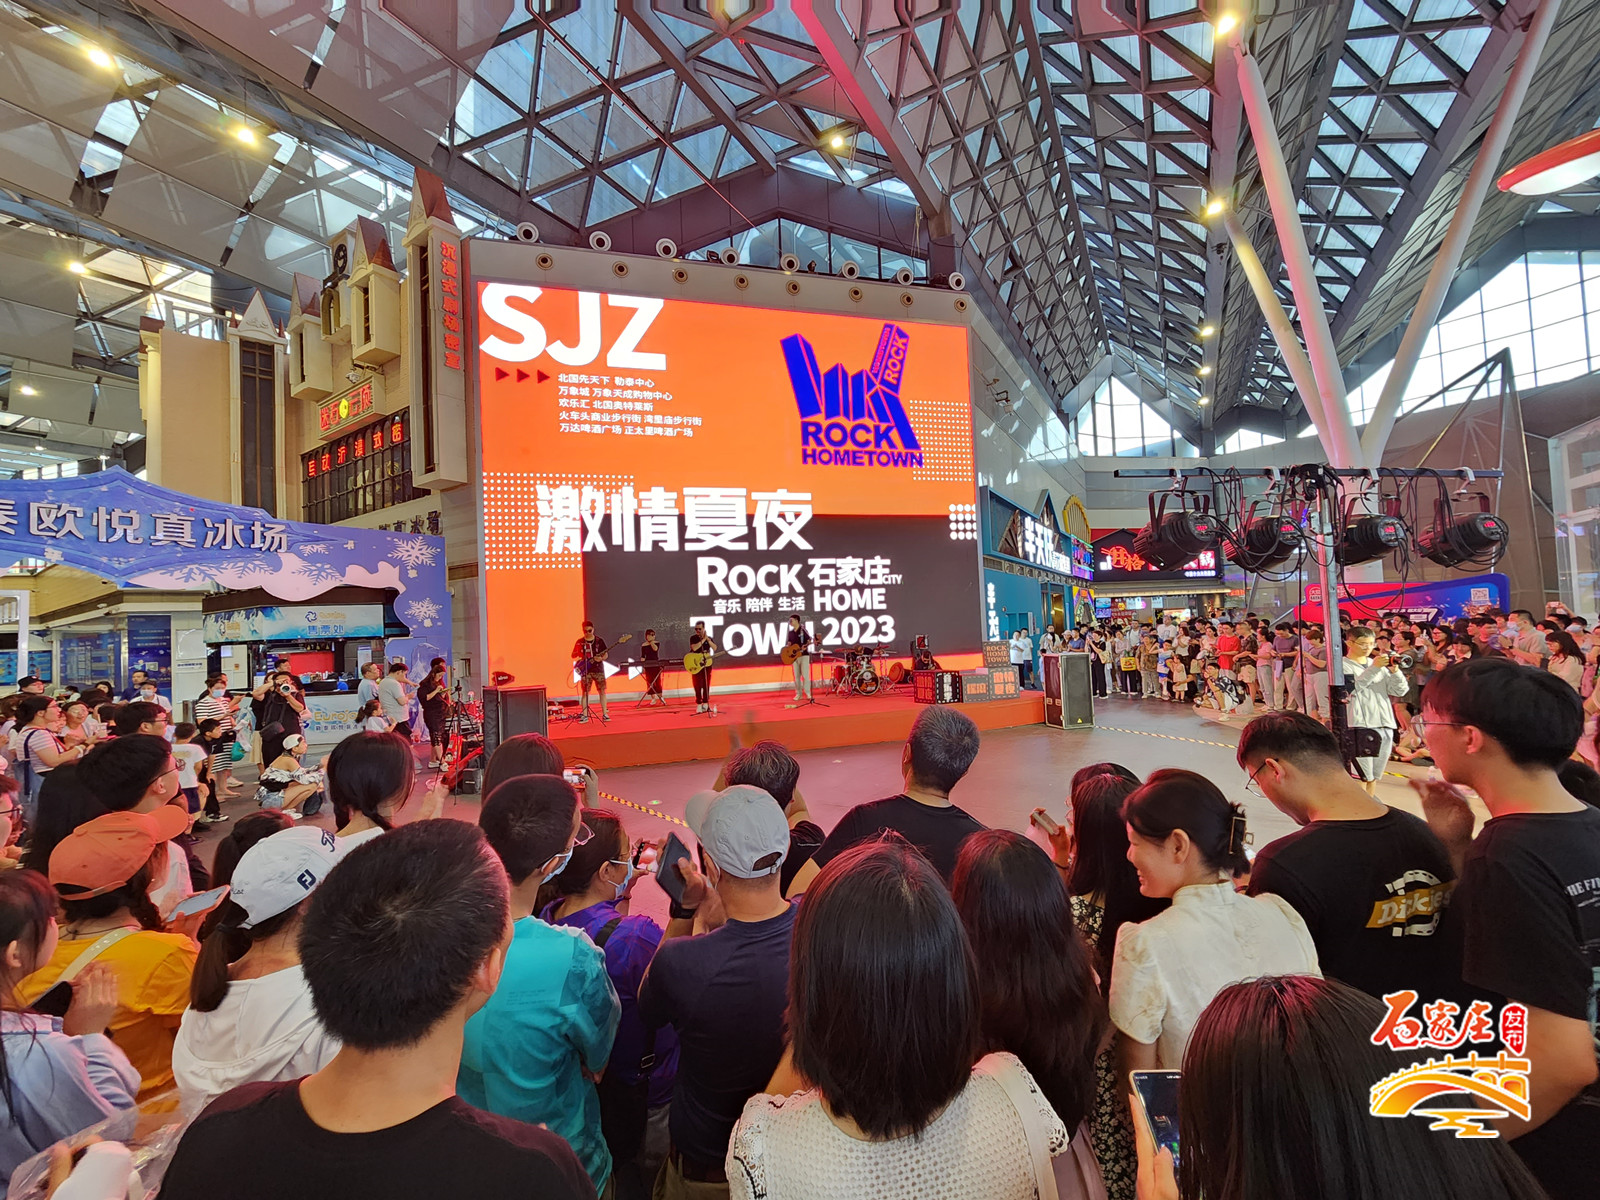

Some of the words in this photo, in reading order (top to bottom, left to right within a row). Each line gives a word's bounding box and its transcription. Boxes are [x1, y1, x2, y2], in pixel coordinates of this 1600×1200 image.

[479, 282, 667, 371] SJZ
[883, 333, 908, 385] ROCK
[558, 373, 610, 385] 北国先天下
[614, 376, 655, 388] 勒泰中心
[558, 385, 590, 397] 万象城
[592, 388, 673, 401] 万象天成购物中心
[558, 398, 590, 409] 欢乐汇
[593, 400, 653, 412] 北国奥特莱斯
[559, 410, 642, 424] 火车头商业步行街
[644, 414, 702, 427] 湾里庙步行街
[559, 422, 622, 435] 万达啤酒广场
[624, 426, 693, 438] 正太里啤酒广场
[800, 421, 898, 449] ROCK
[802, 448, 923, 468] HOMETOWN
[534, 486, 813, 555] 激情夏夜
[696, 556, 805, 597] ROCK
[807, 555, 891, 588] 石家庄
[881, 574, 902, 585] CITY
[713, 598, 742, 614] 音乐
[745, 597, 773, 613] 陪伴
[778, 596, 806, 612] 生活
[813, 587, 888, 613] HOME
[307, 624, 345, 635] 售票处
[821, 614, 897, 646] 2023
[314, 709, 358, 724] Eurojo
[1564, 881, 1586, 897] HE
